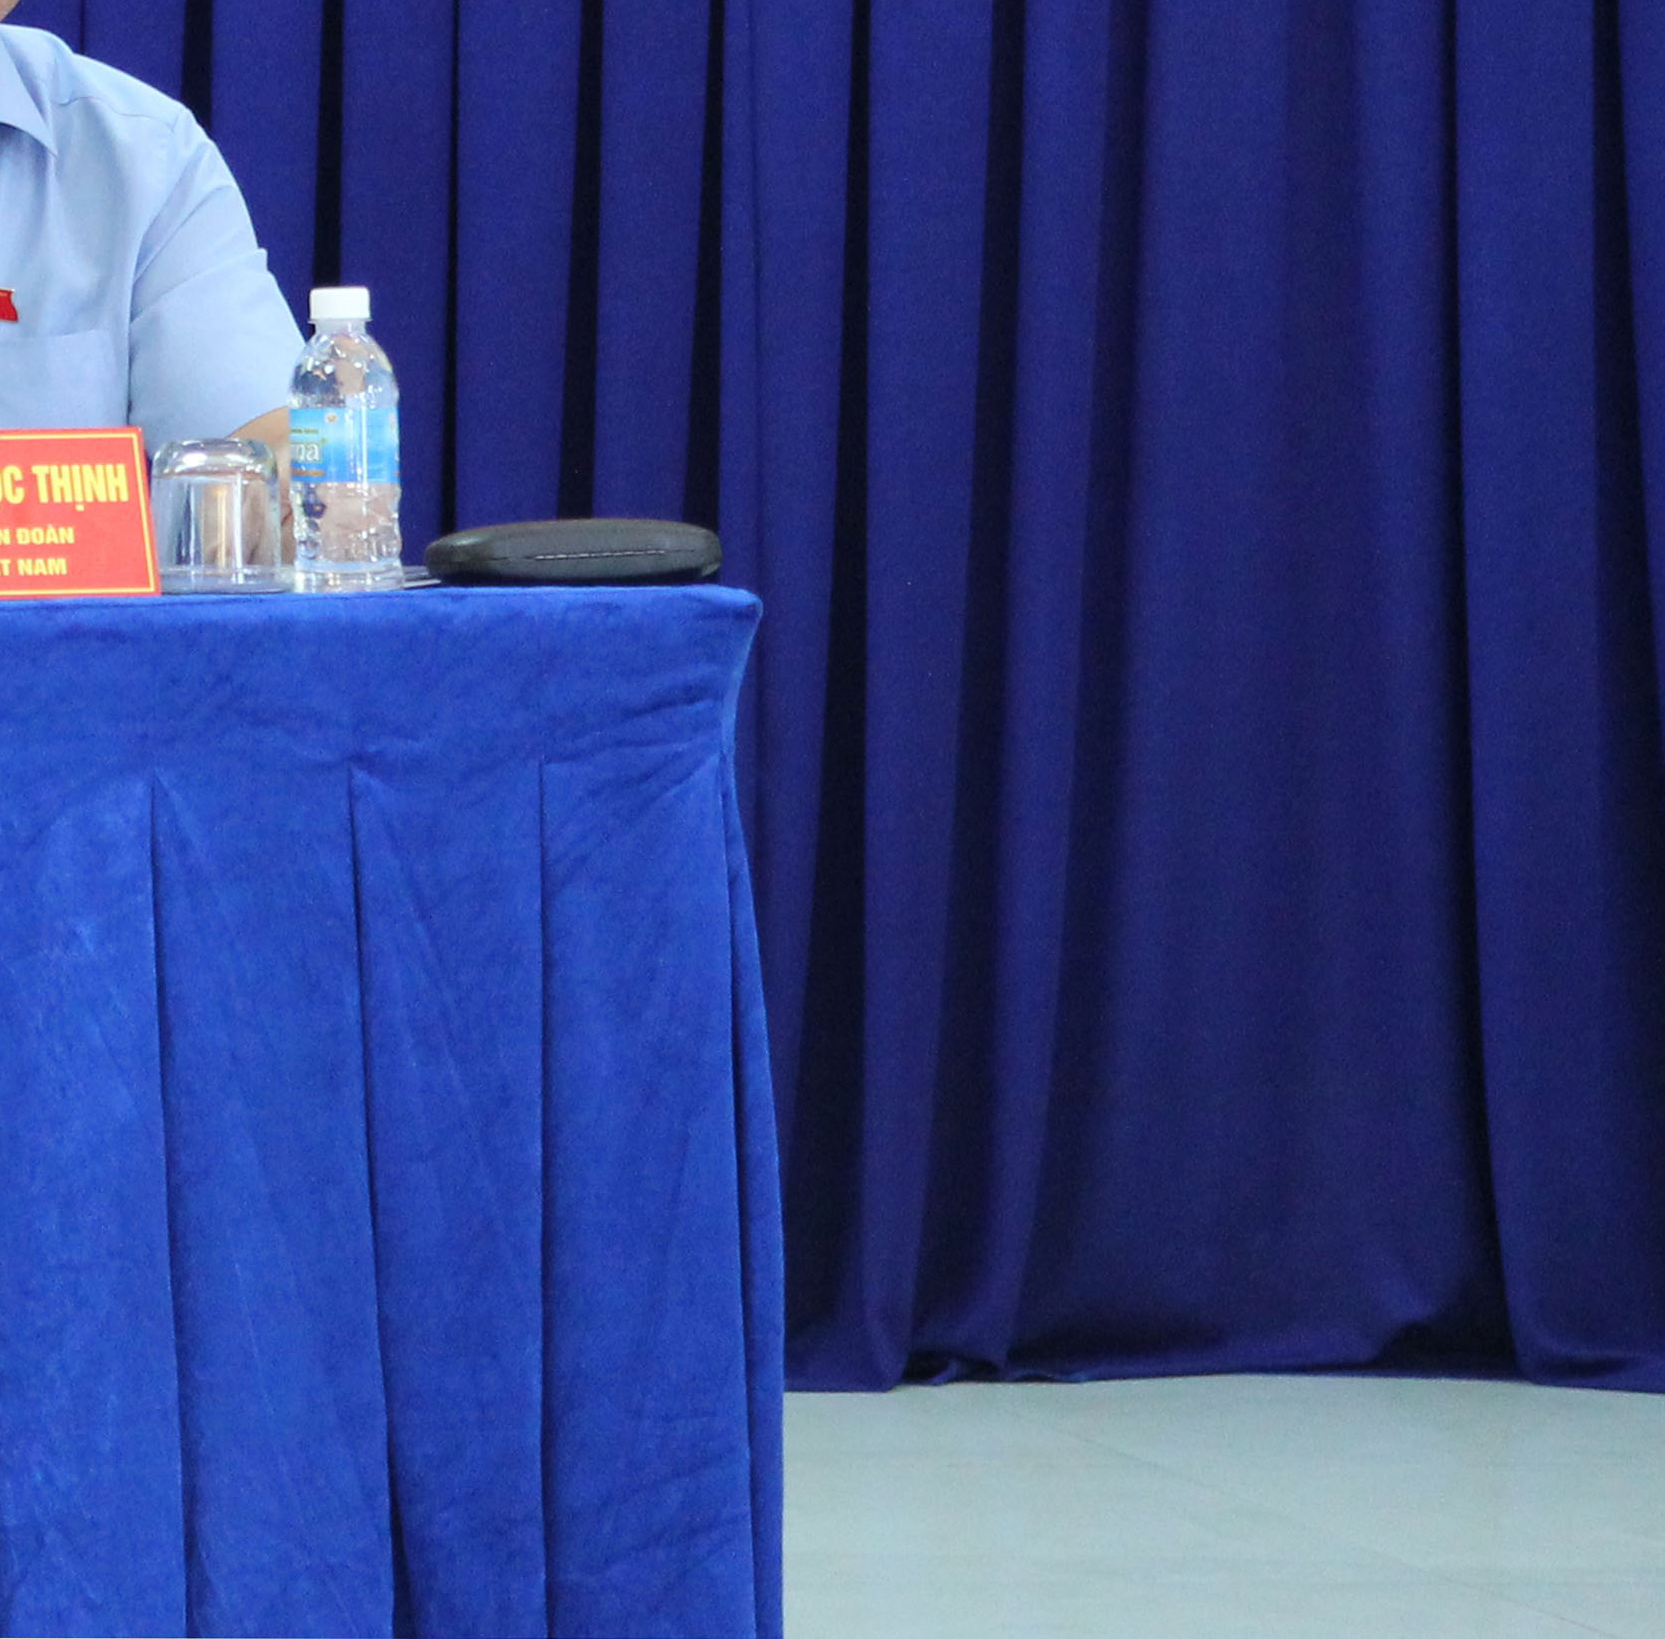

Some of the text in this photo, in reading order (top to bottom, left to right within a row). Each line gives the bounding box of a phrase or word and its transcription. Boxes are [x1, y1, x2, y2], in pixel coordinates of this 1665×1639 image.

[32, 463, 130, 511] THỊNH
[15, 523, 76, 545] ĐOÀN
[17, 557, 68, 576] NAM
